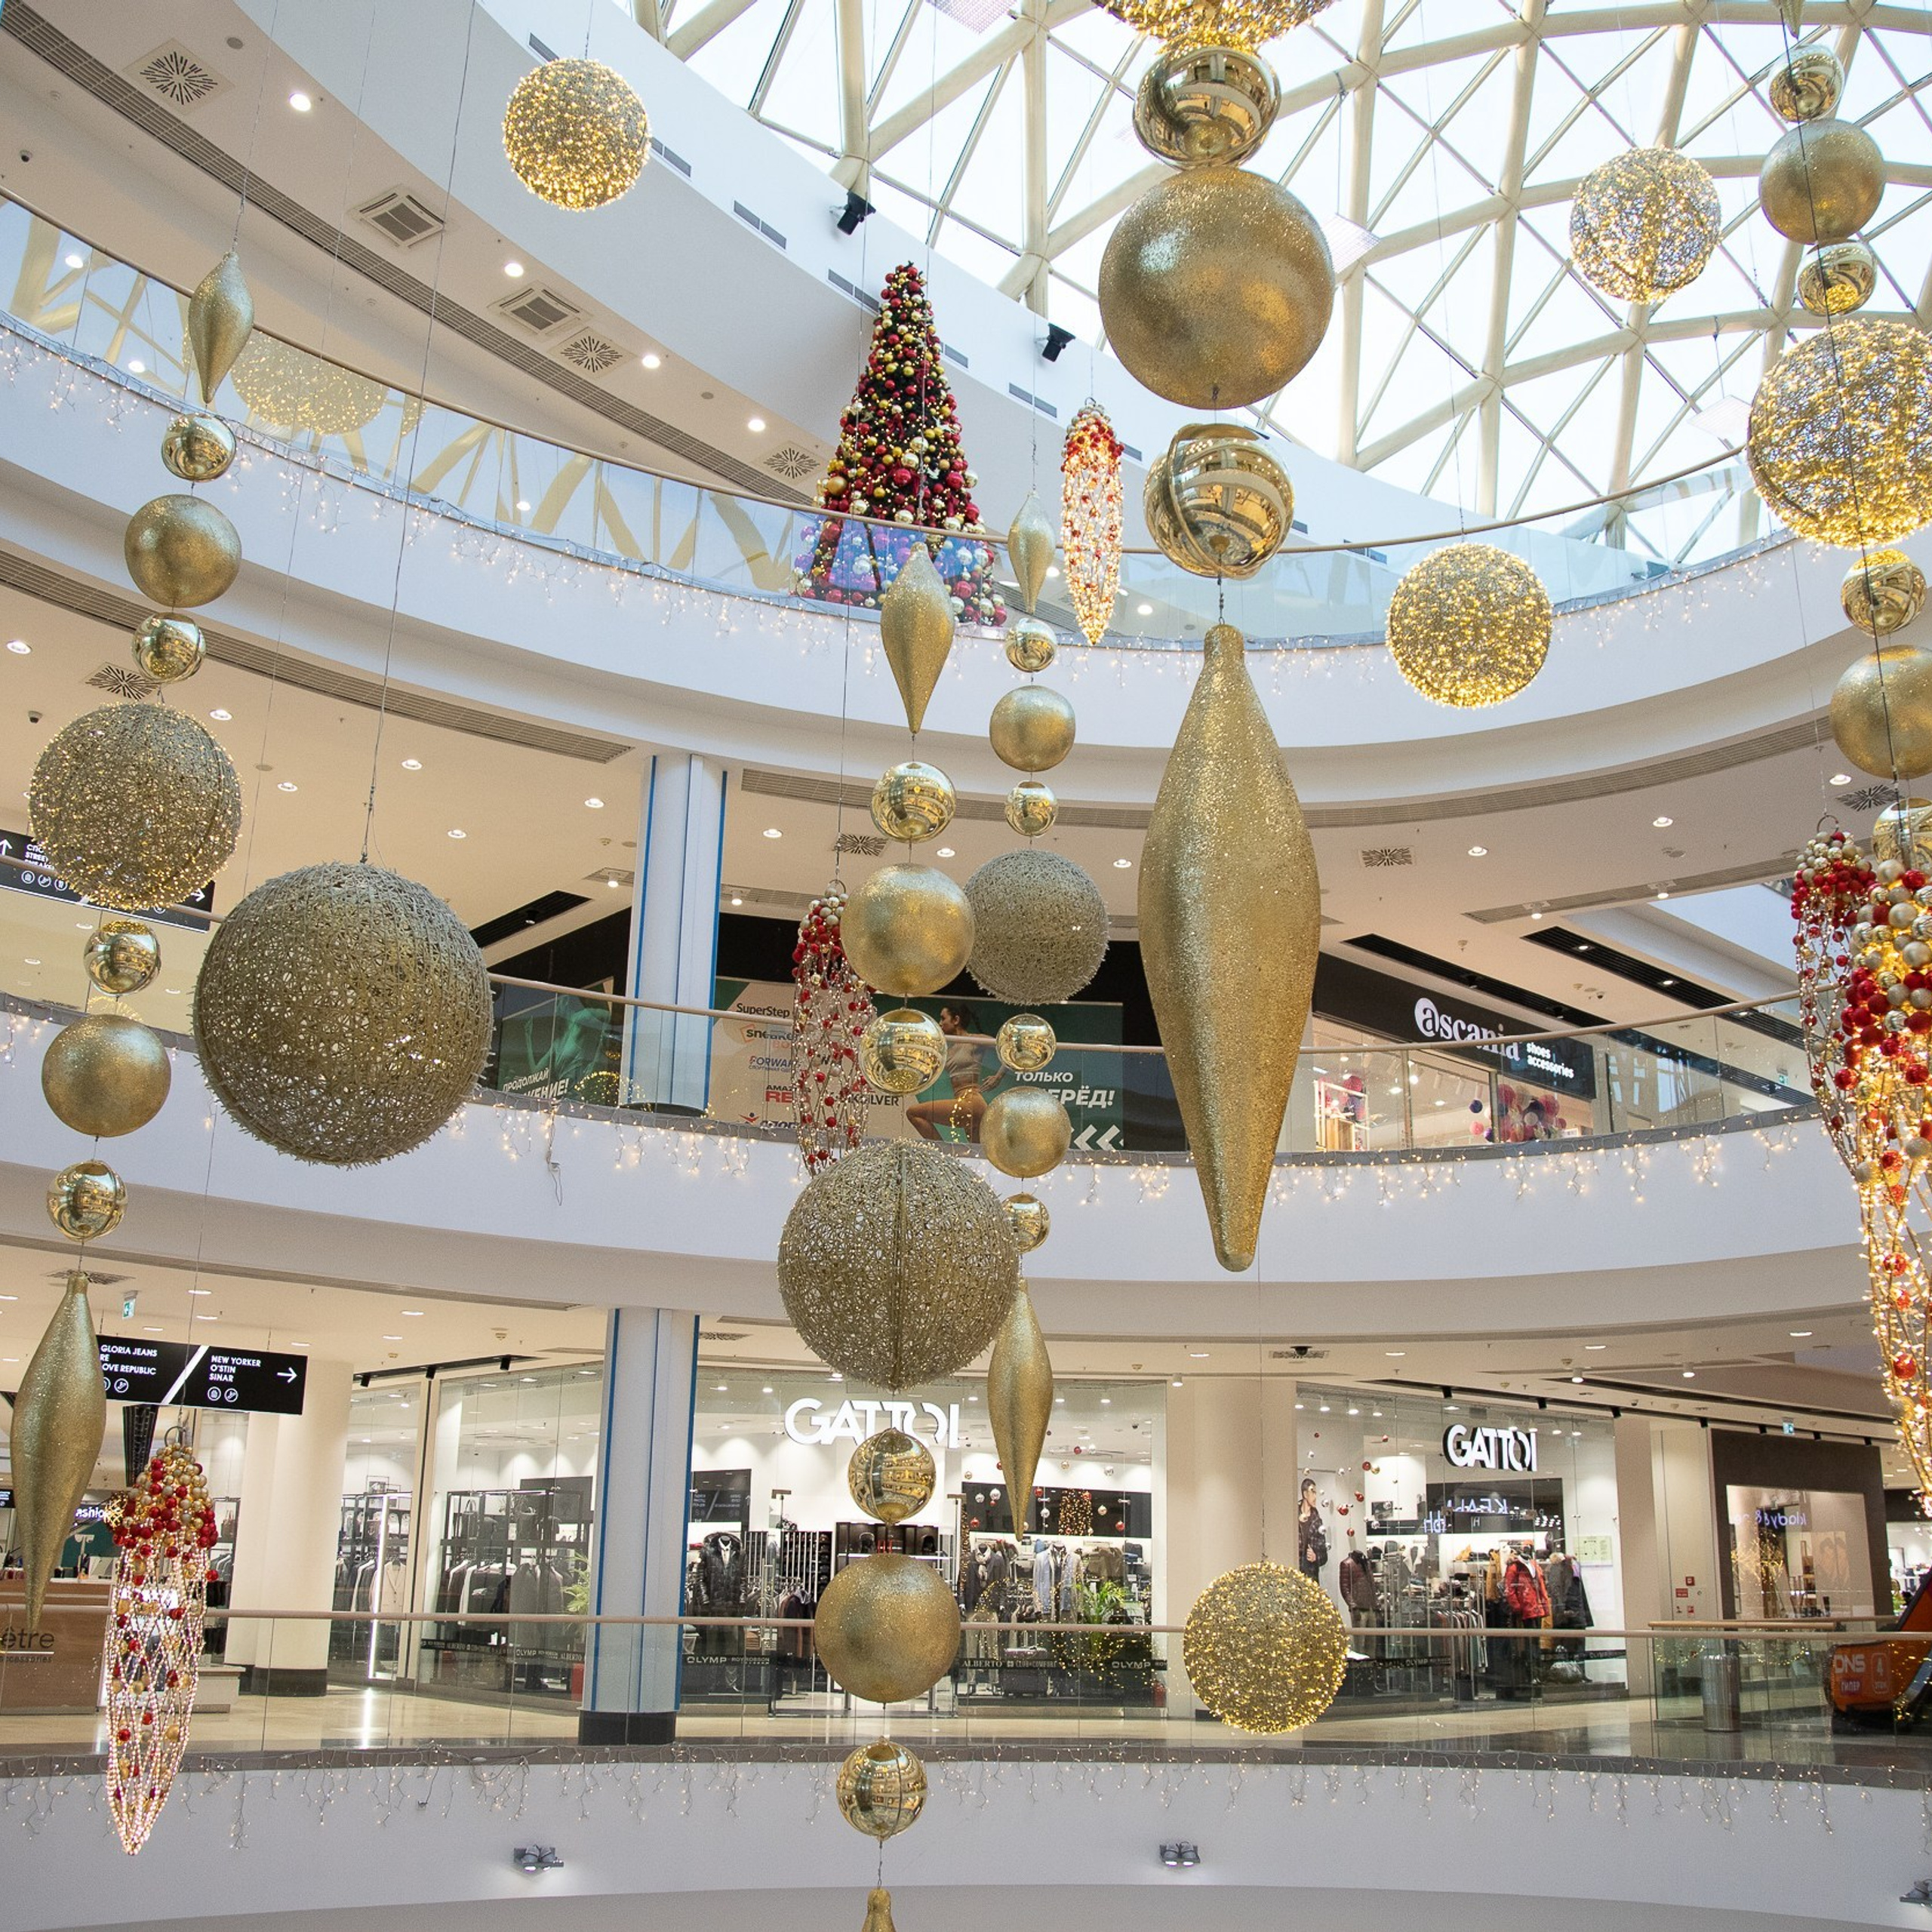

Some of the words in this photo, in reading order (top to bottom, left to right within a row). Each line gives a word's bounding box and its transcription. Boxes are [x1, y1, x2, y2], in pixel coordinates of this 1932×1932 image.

[736, 1003, 790, 1018] SuperStep
[1526, 1041, 1551, 1060] shoes
[1527, 1054, 1574, 1078] accessories
[503, 1068, 549, 1092] ПРОДОЛЖАЙ
[1015, 1072, 1073, 1083] ТОЛЬКО
[100, 1344, 131, 1355] GLORIA
[132, 1347, 158, 1357] JEANS
[211, 1355, 229, 1364] NEW
[231, 1357, 261, 1367] YORKER
[102, 1364, 118, 1373] OVE
[119, 1366, 157, 1376] REPUBLIC
[210, 1364, 235, 1374] O'STIN
[209, 1373, 234, 1383] SINAR
[76, 1506, 108, 1518] ashio
[516, 1648, 537, 1657] OLYMP
[1112, 1660, 1151, 1669] OLYMP
[1834, 1654, 1865, 1674] DNS
